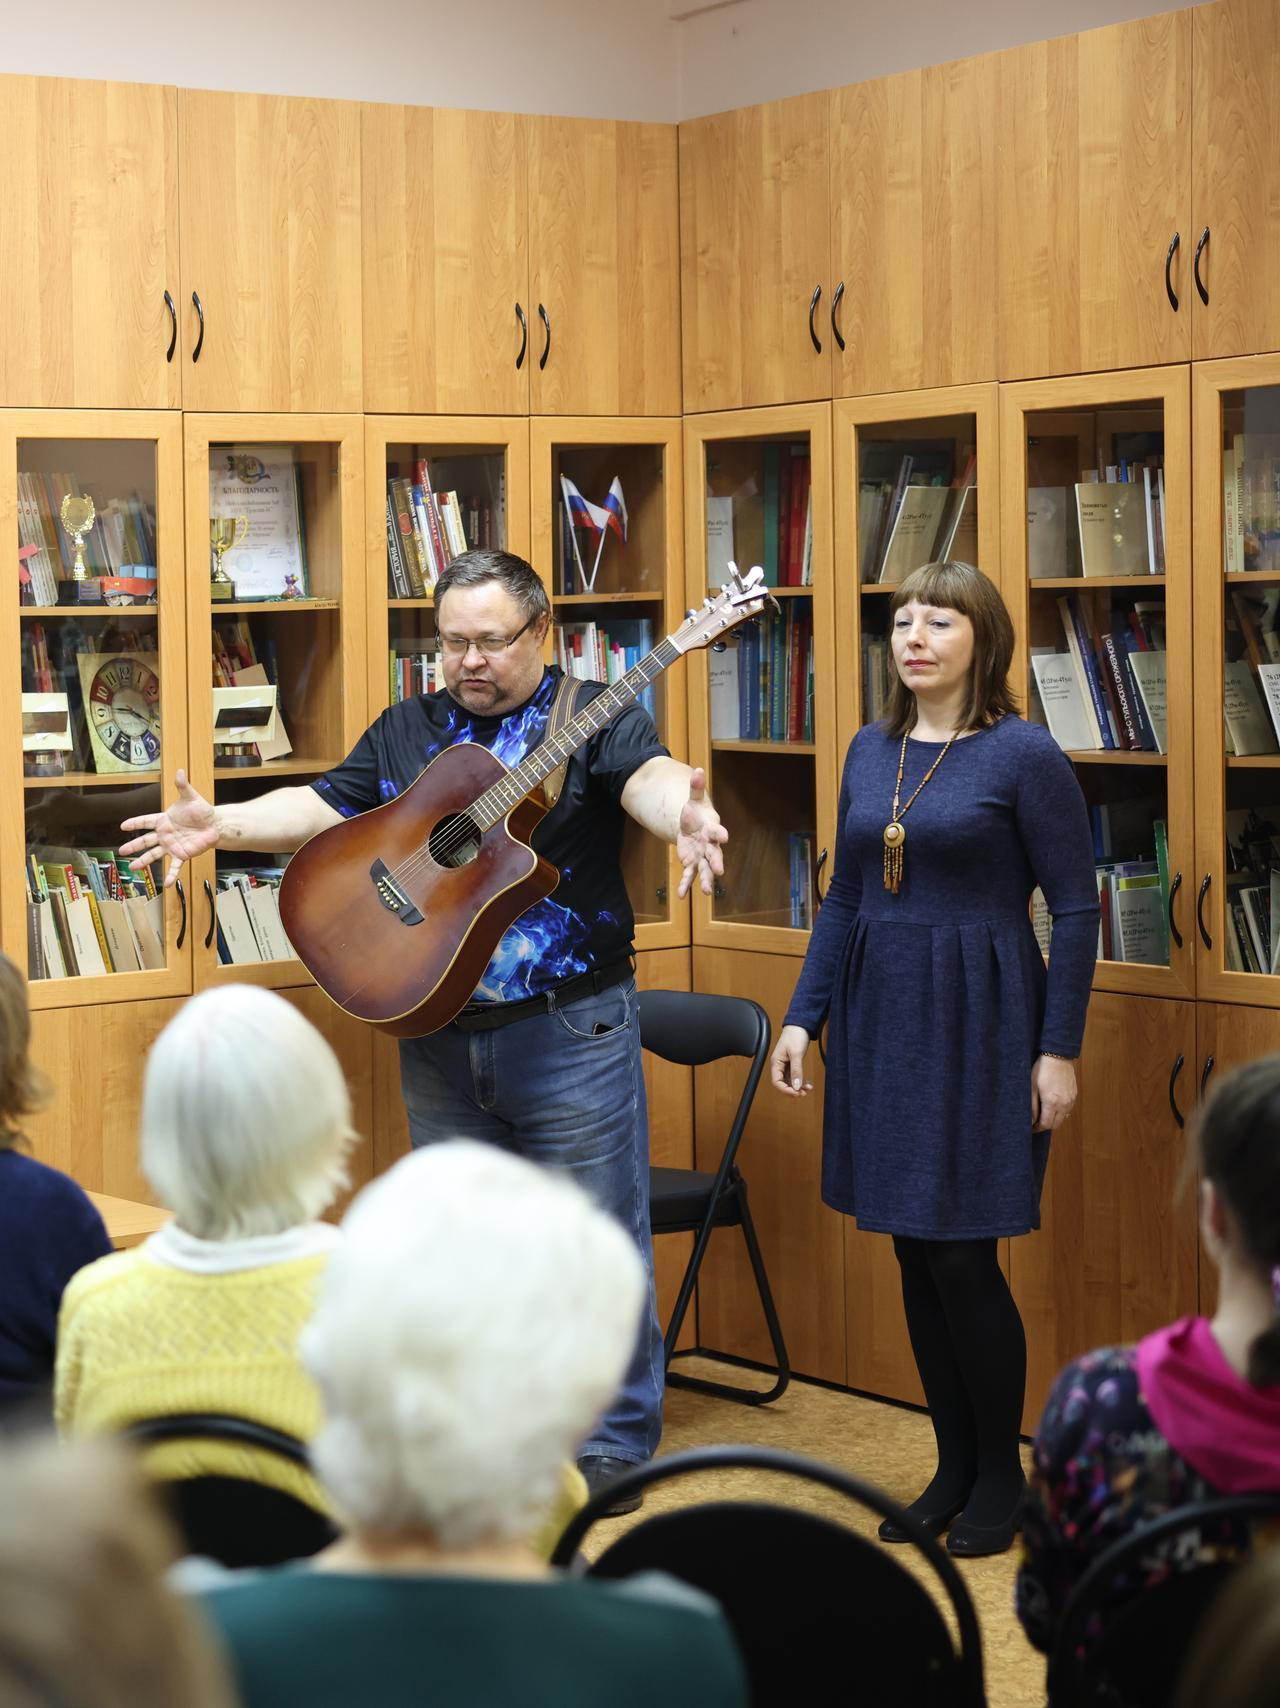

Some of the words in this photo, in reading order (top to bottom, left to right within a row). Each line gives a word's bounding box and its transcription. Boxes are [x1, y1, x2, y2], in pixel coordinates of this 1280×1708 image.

[1105, 638, 1122, 683] ОРУЖЕЙНОГО
[97, 686, 109, 700] 10
[1117, 683, 1131, 720] ТУЛЬСКОГО
[120, 737, 128, 751] 7
[134, 742, 143, 756] 6
[146, 737, 157, 752] 5
